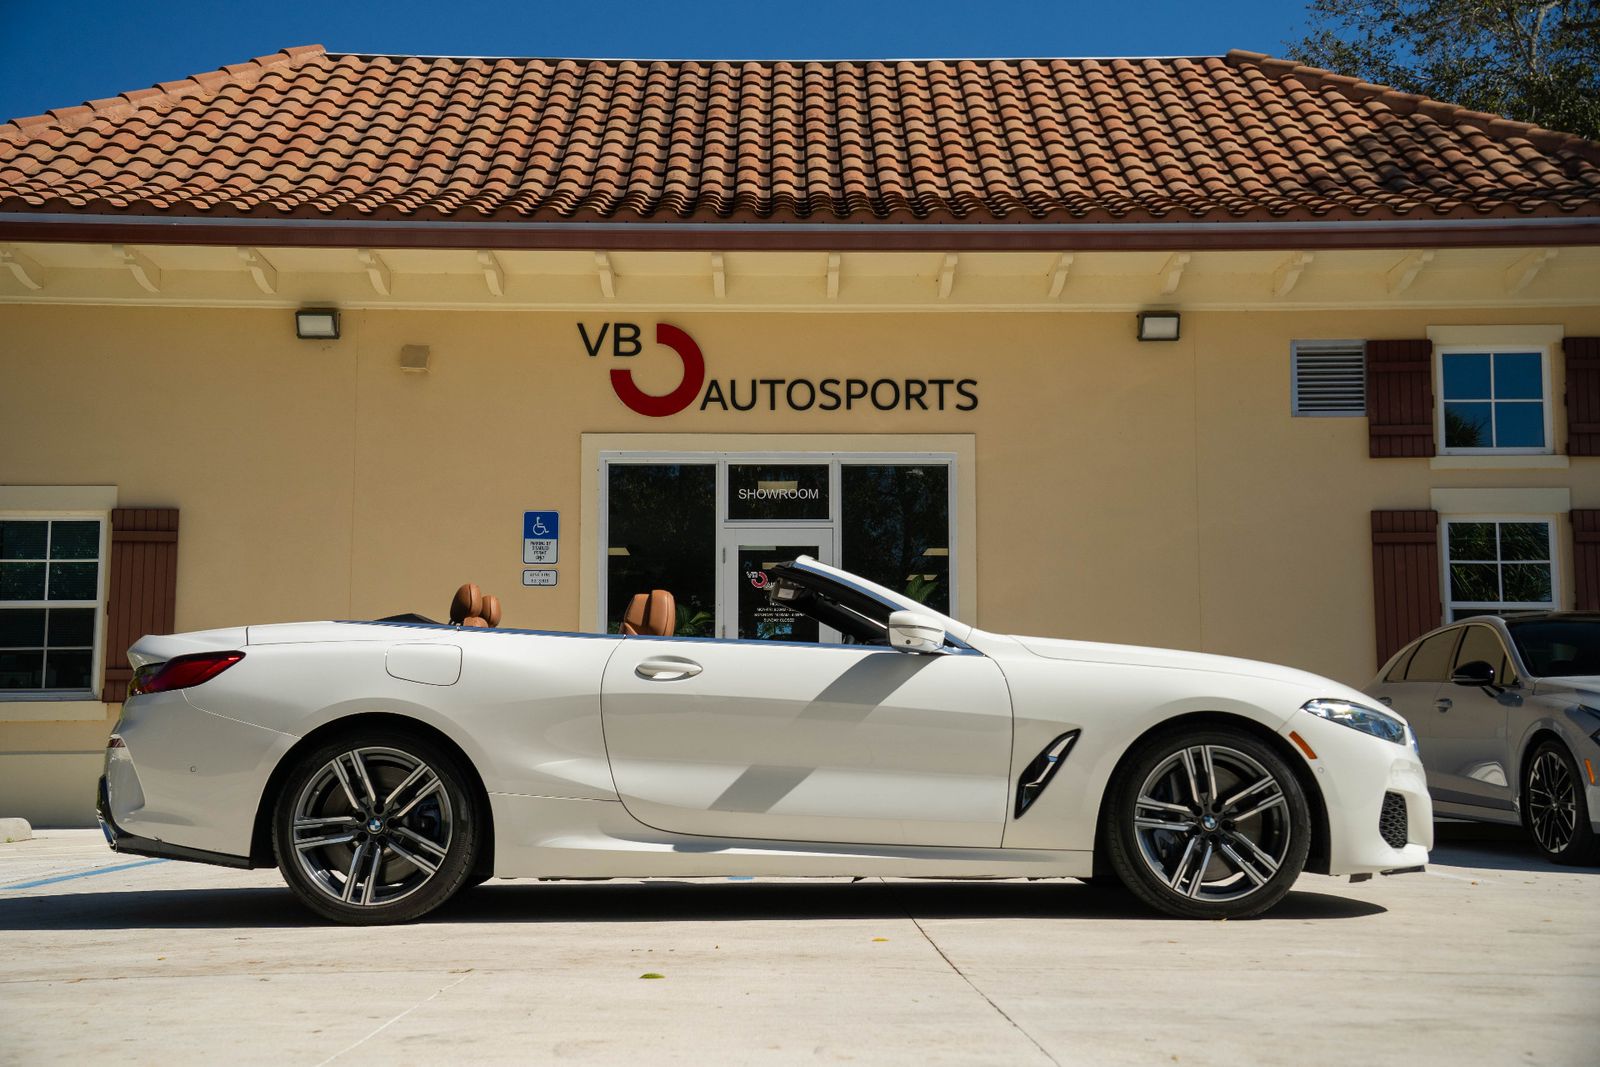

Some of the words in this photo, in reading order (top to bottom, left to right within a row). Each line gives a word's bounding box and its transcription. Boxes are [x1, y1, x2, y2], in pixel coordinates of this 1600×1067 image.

[577, 322, 642, 357] VB
[699, 378, 979, 411] AUTOSPORTS
[738, 488, 819, 500] SHOWROOM
